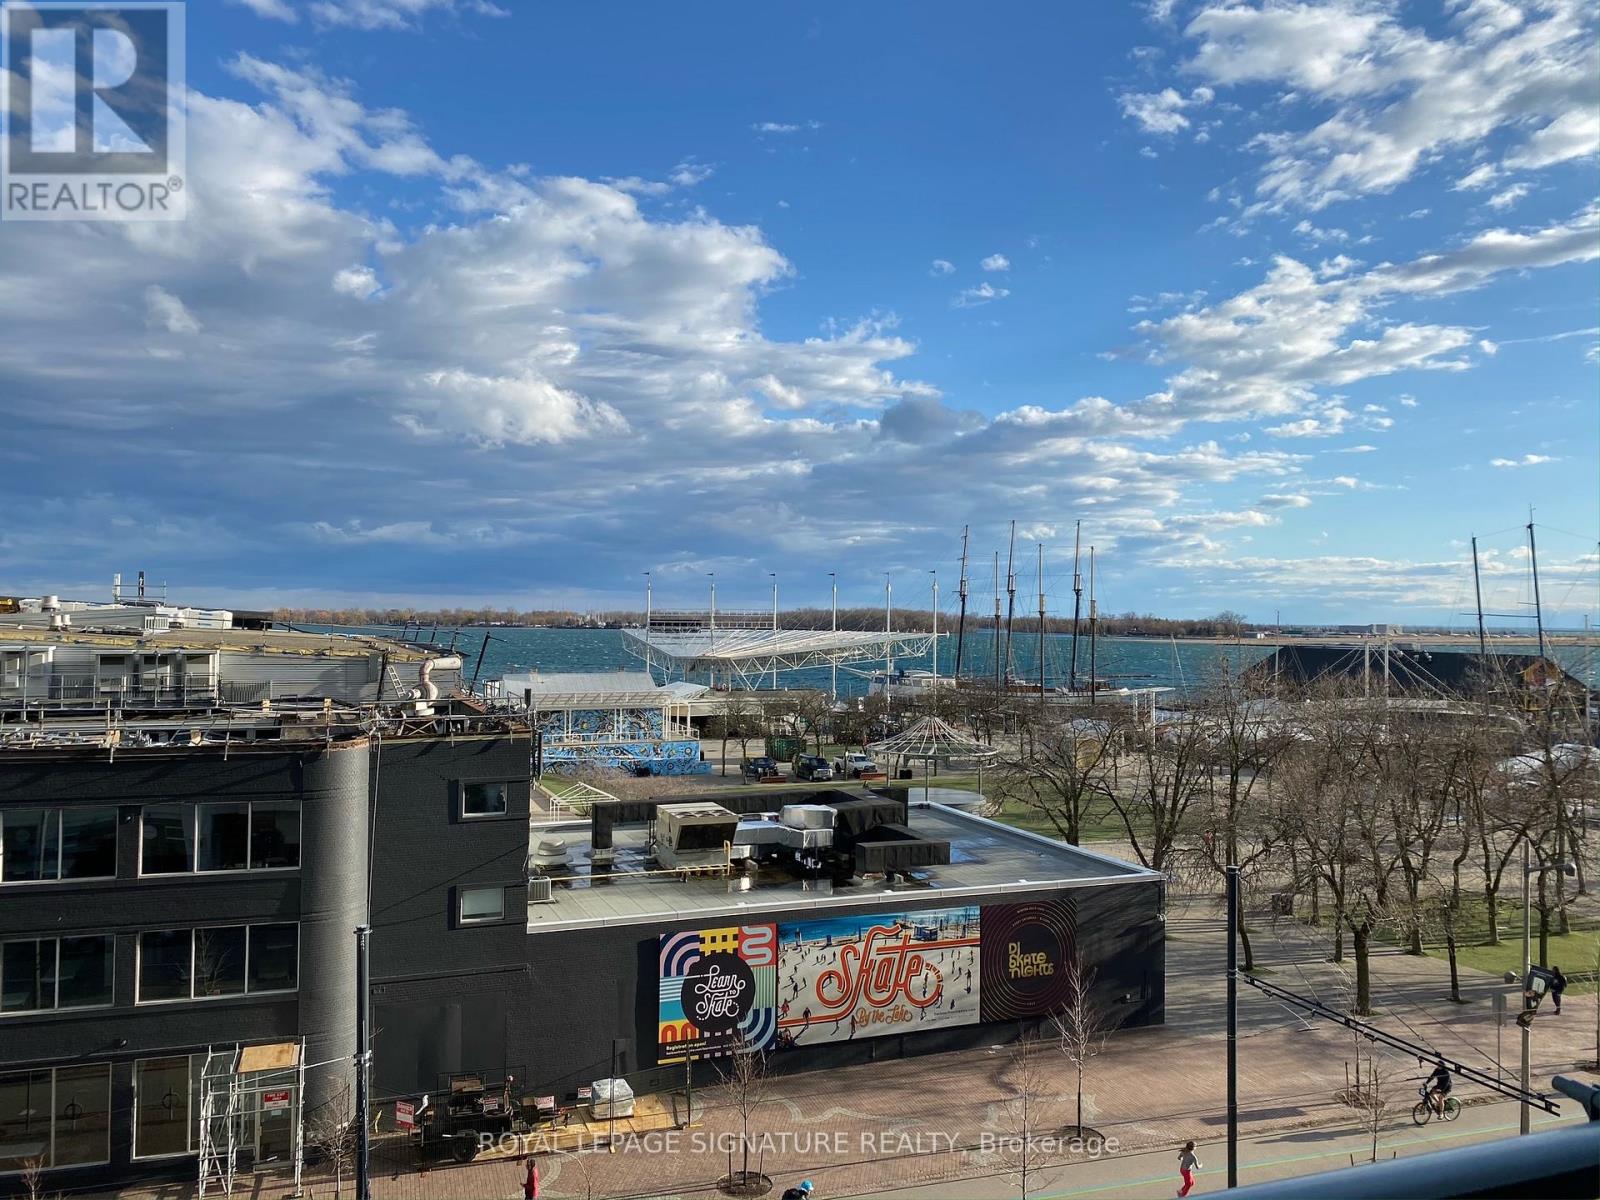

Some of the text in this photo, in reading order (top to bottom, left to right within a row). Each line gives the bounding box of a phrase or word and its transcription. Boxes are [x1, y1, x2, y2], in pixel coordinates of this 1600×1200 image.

[694, 964, 746, 995] Learn
[815, 923, 944, 1009] Skate
[696, 991, 740, 1020] Skate
[855, 1009, 870, 1027] By
[885, 1004, 914, 1025] Lake
